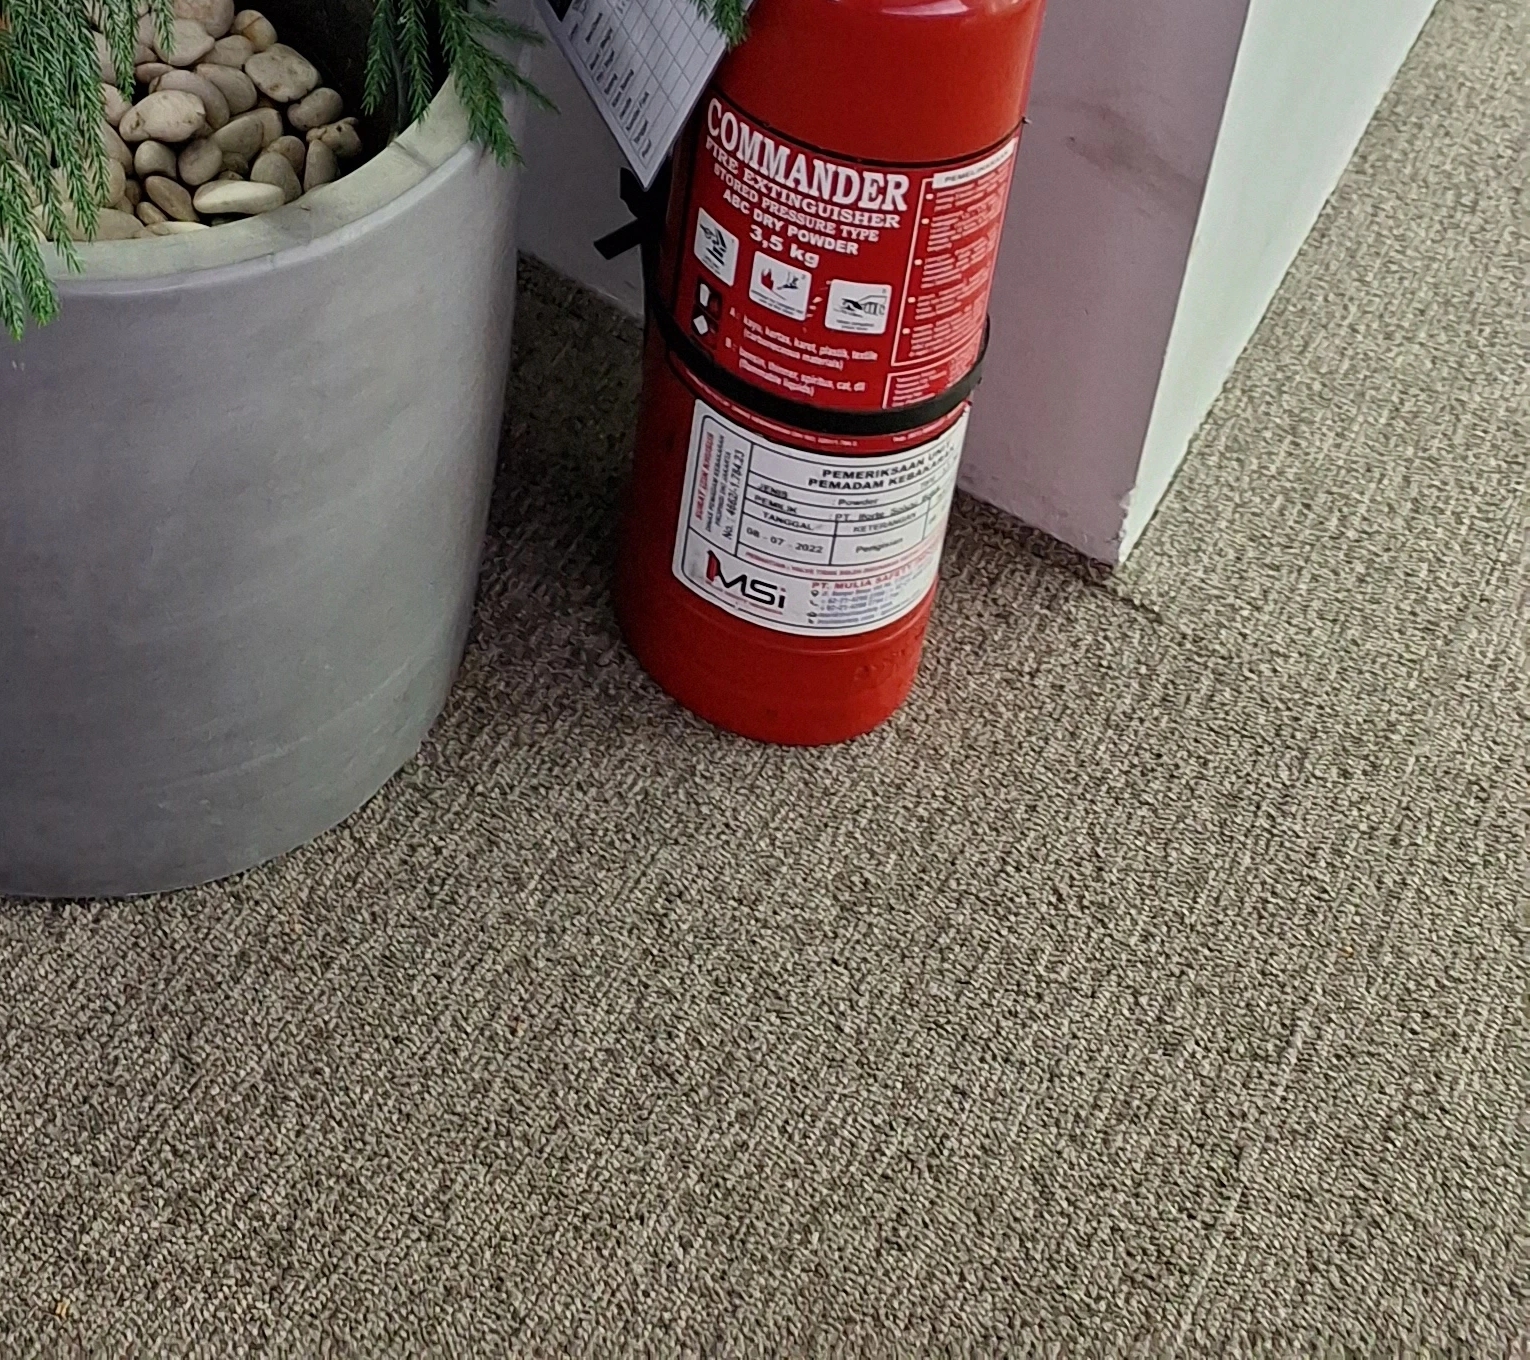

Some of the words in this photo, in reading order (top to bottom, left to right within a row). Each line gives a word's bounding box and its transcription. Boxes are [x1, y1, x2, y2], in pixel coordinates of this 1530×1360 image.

[707, 97, 910, 212] COMMANDER
[705, 135, 739, 175] FIRE
[742, 167, 901, 229] EXTINGUISHER
[714, 163, 759, 204] STORED
[761, 196, 837, 236] PRESSURE
[840, 224, 880, 243] TYPE
[723, 189, 750, 215] ABC
[753, 208, 785, 232] DRY
[787, 221, 859, 256] POWDER
[749, 224, 784, 253] 3,5
[789, 243, 820, 269] kg
[807, 477, 884, 490] PEMADAM
[821, 458, 925, 480] PEMERIKSAAN
[762, 511, 814, 531] TANGGAL
[794, 542, 823, 554] 2022
